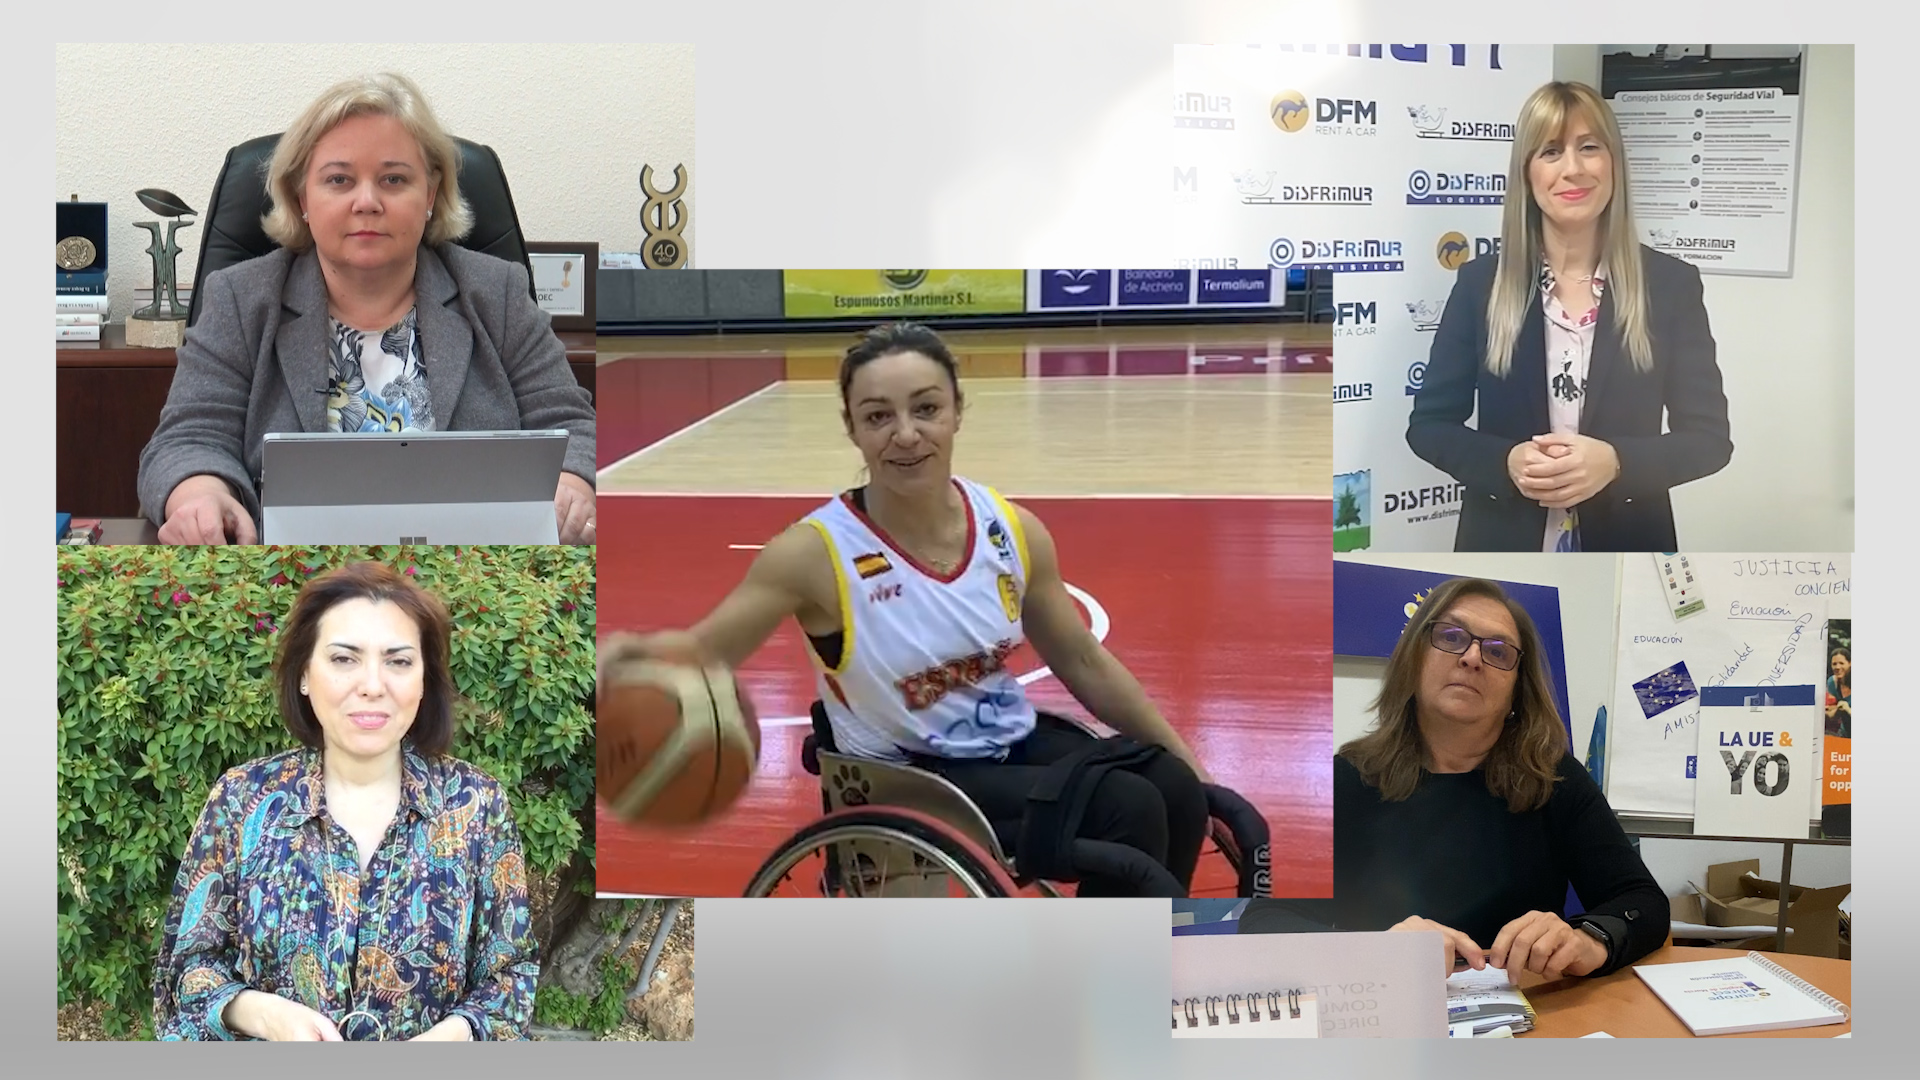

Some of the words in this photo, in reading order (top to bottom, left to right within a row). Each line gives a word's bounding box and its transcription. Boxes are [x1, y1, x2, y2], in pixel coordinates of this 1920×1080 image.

[1621, 93, 1658, 104] Consejos
[1660, 91, 1691, 102] básicos
[1693, 92, 1705, 101] de
[1706, 91, 1755, 102] Seguridad
[1757, 90, 1775, 99] Vial
[1316, 98, 1377, 125] DFM
[1315, 126, 1342, 136] RENT
[1346, 127, 1353, 136] A
[1356, 127, 1377, 137] CAR
[654, 243, 676, 258] 40
[1124, 282, 1137, 293] de
[1139, 280, 1184, 293] Archena
[1203, 278, 1265, 292] Termalium
[834, 295, 900, 309] Espumosos
[1346, 328, 1353, 336] A
[1356, 326, 1377, 336] CAR
[1733, 558, 1838, 577] JUSTICIA
[1633, 632, 1683, 644] EDUCACIÓN
[1719, 731, 1744, 747] LA
[1748, 731, 1774, 747] UE
[1779, 731, 1794, 747] &
[1719, 750, 1790, 797] YO
[1829, 764, 1850, 776] for
